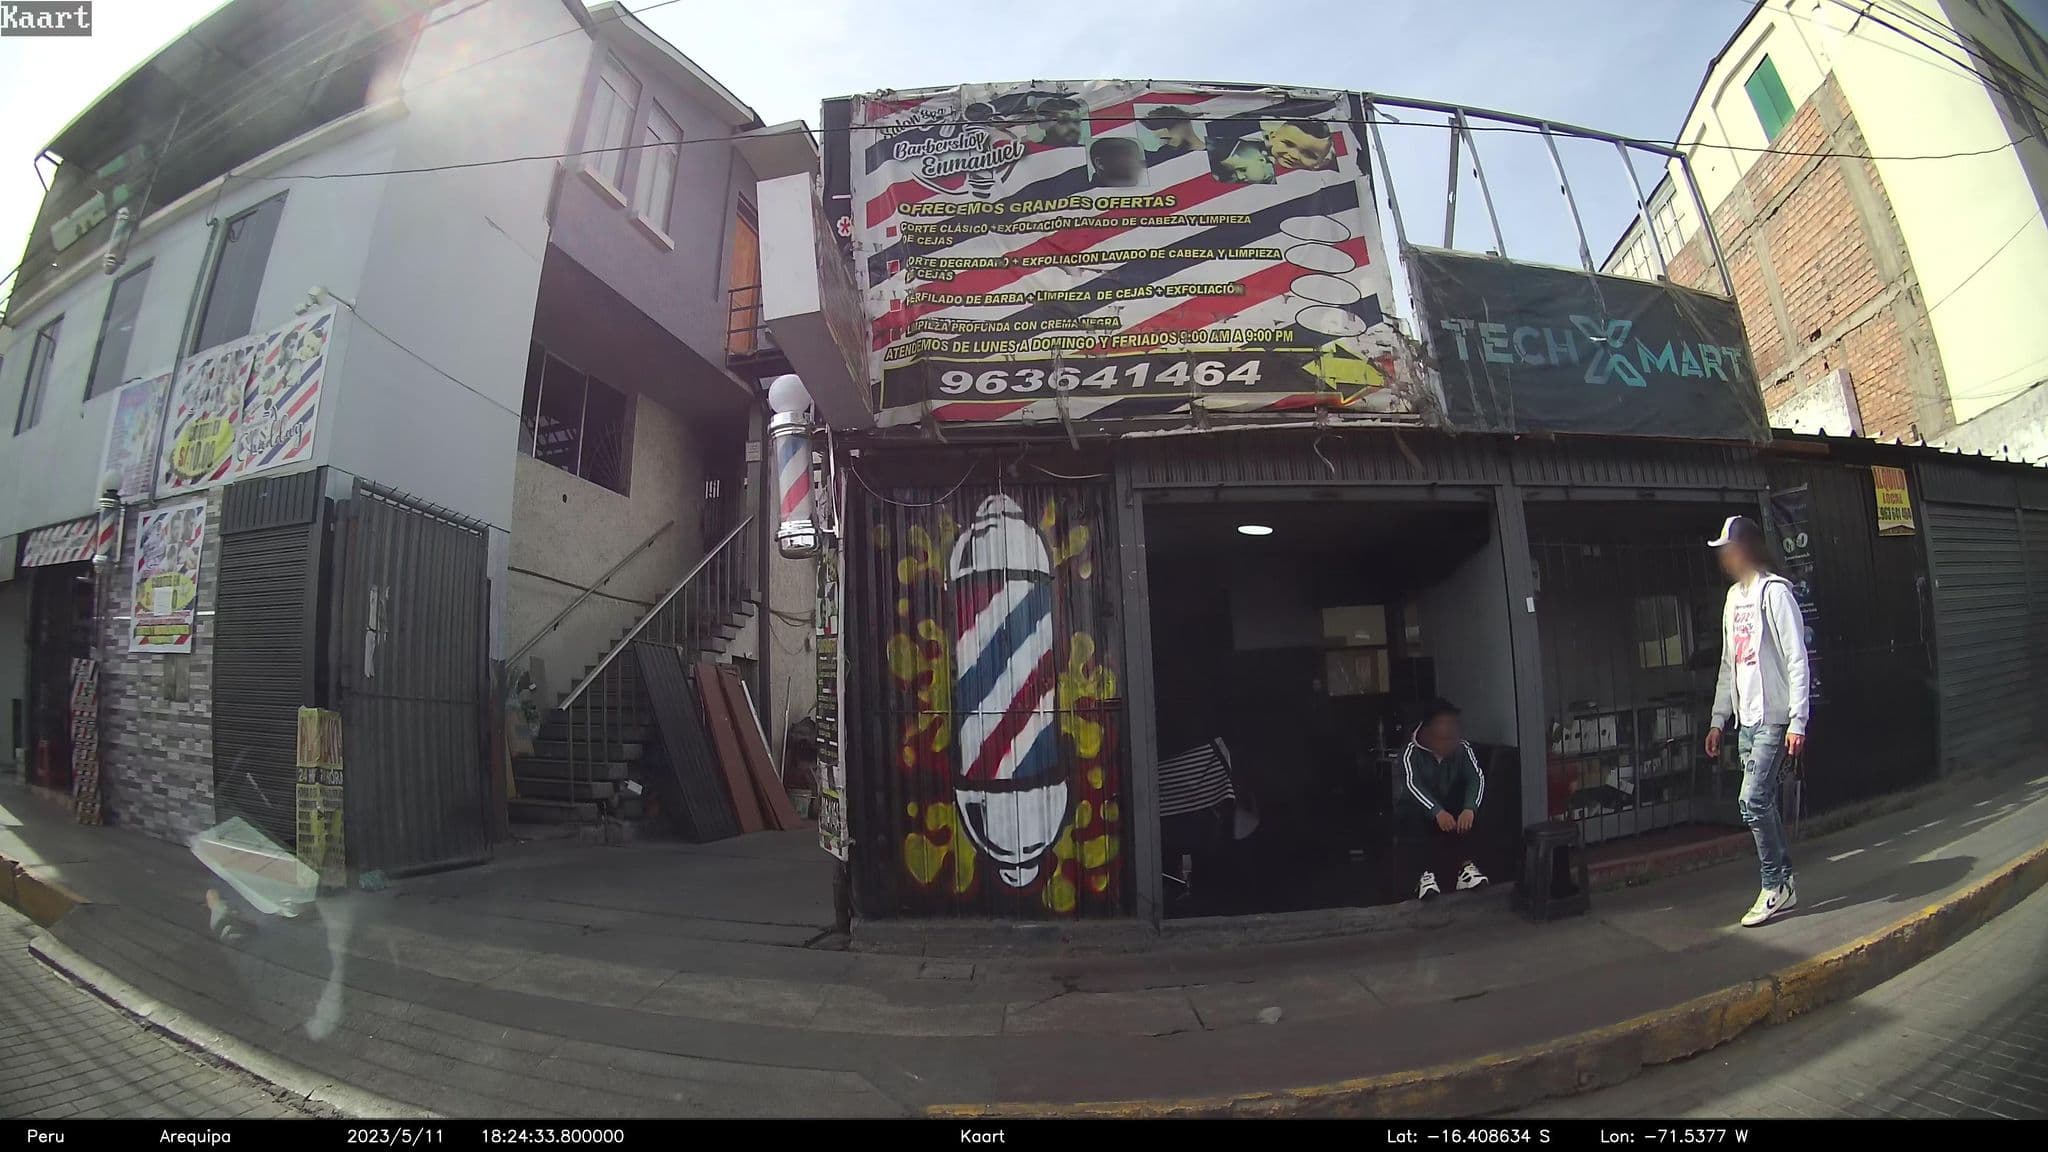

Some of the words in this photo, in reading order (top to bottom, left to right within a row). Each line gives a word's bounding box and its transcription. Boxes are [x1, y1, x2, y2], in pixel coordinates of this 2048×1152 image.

[895, 132, 988, 159] Barbershop
[922, 142, 1022, 174] Enmanuel
[899, 202, 1005, 216] OFRECEMOS
[1009, 196, 1092, 213] GRANDES
[1096, 195, 1176, 209] OFERTAS
[901, 222, 936, 233] CORTE
[940, 223, 988, 233] CLÁSICO
[1074, 217, 1118, 227] LAVADO
[1122, 217, 1137, 226] DE
[1140, 215, 1186, 225] CABEZA
[1188, 215, 1196, 224] Y
[1199, 214, 1251, 224] LIMPIEZA
[917, 236, 953, 245] CEJAS
[907, 256, 937, 267] ORTE
[1101, 249, 1147, 261] LAVADO
[1150, 249, 1165, 259] DE
[1168, 248, 1214, 258] CABEZA
[1217, 249, 1227, 258] Y
[1228, 248, 1281, 259] LIMPIEZA
[917, 269, 954, 281] CEJAS
[966, 294, 982, 304] DE
[984, 293, 1024, 304] BARBA
[1037, 291, 1091, 301] LIMPIEZA
[1097, 290, 1112, 300] DE
[1116, 286, 1152, 298] CEJAS
[951, 321, 1010, 333] PROFUNDA
[1014, 320, 1037, 331] CON
[1040, 319, 1079, 331] CREMA
[1081, 317, 1119, 328] NEGRA
[885, 338, 949, 361] ATENDEMOS
[952, 341, 970, 352] DE
[973, 340, 1016, 353] LUNES
[1018, 339, 1028, 352] A
[1032, 335, 1095, 352] DOMINGO
[1099, 335, 1110, 348] Y
[1112, 332, 1181, 348] FERIADOS
[1180, 330, 1206, 344] 9:00
[1210, 330, 1230, 343] AM
[1233, 329, 1243, 342] A
[1246, 329, 1272, 342] 9:00
[1275, 329, 1293, 343] PM
[1440, 318, 1580, 366] TECH
[1634, 336, 1742, 381] MART
[939, 360, 1262, 394] 963641464
